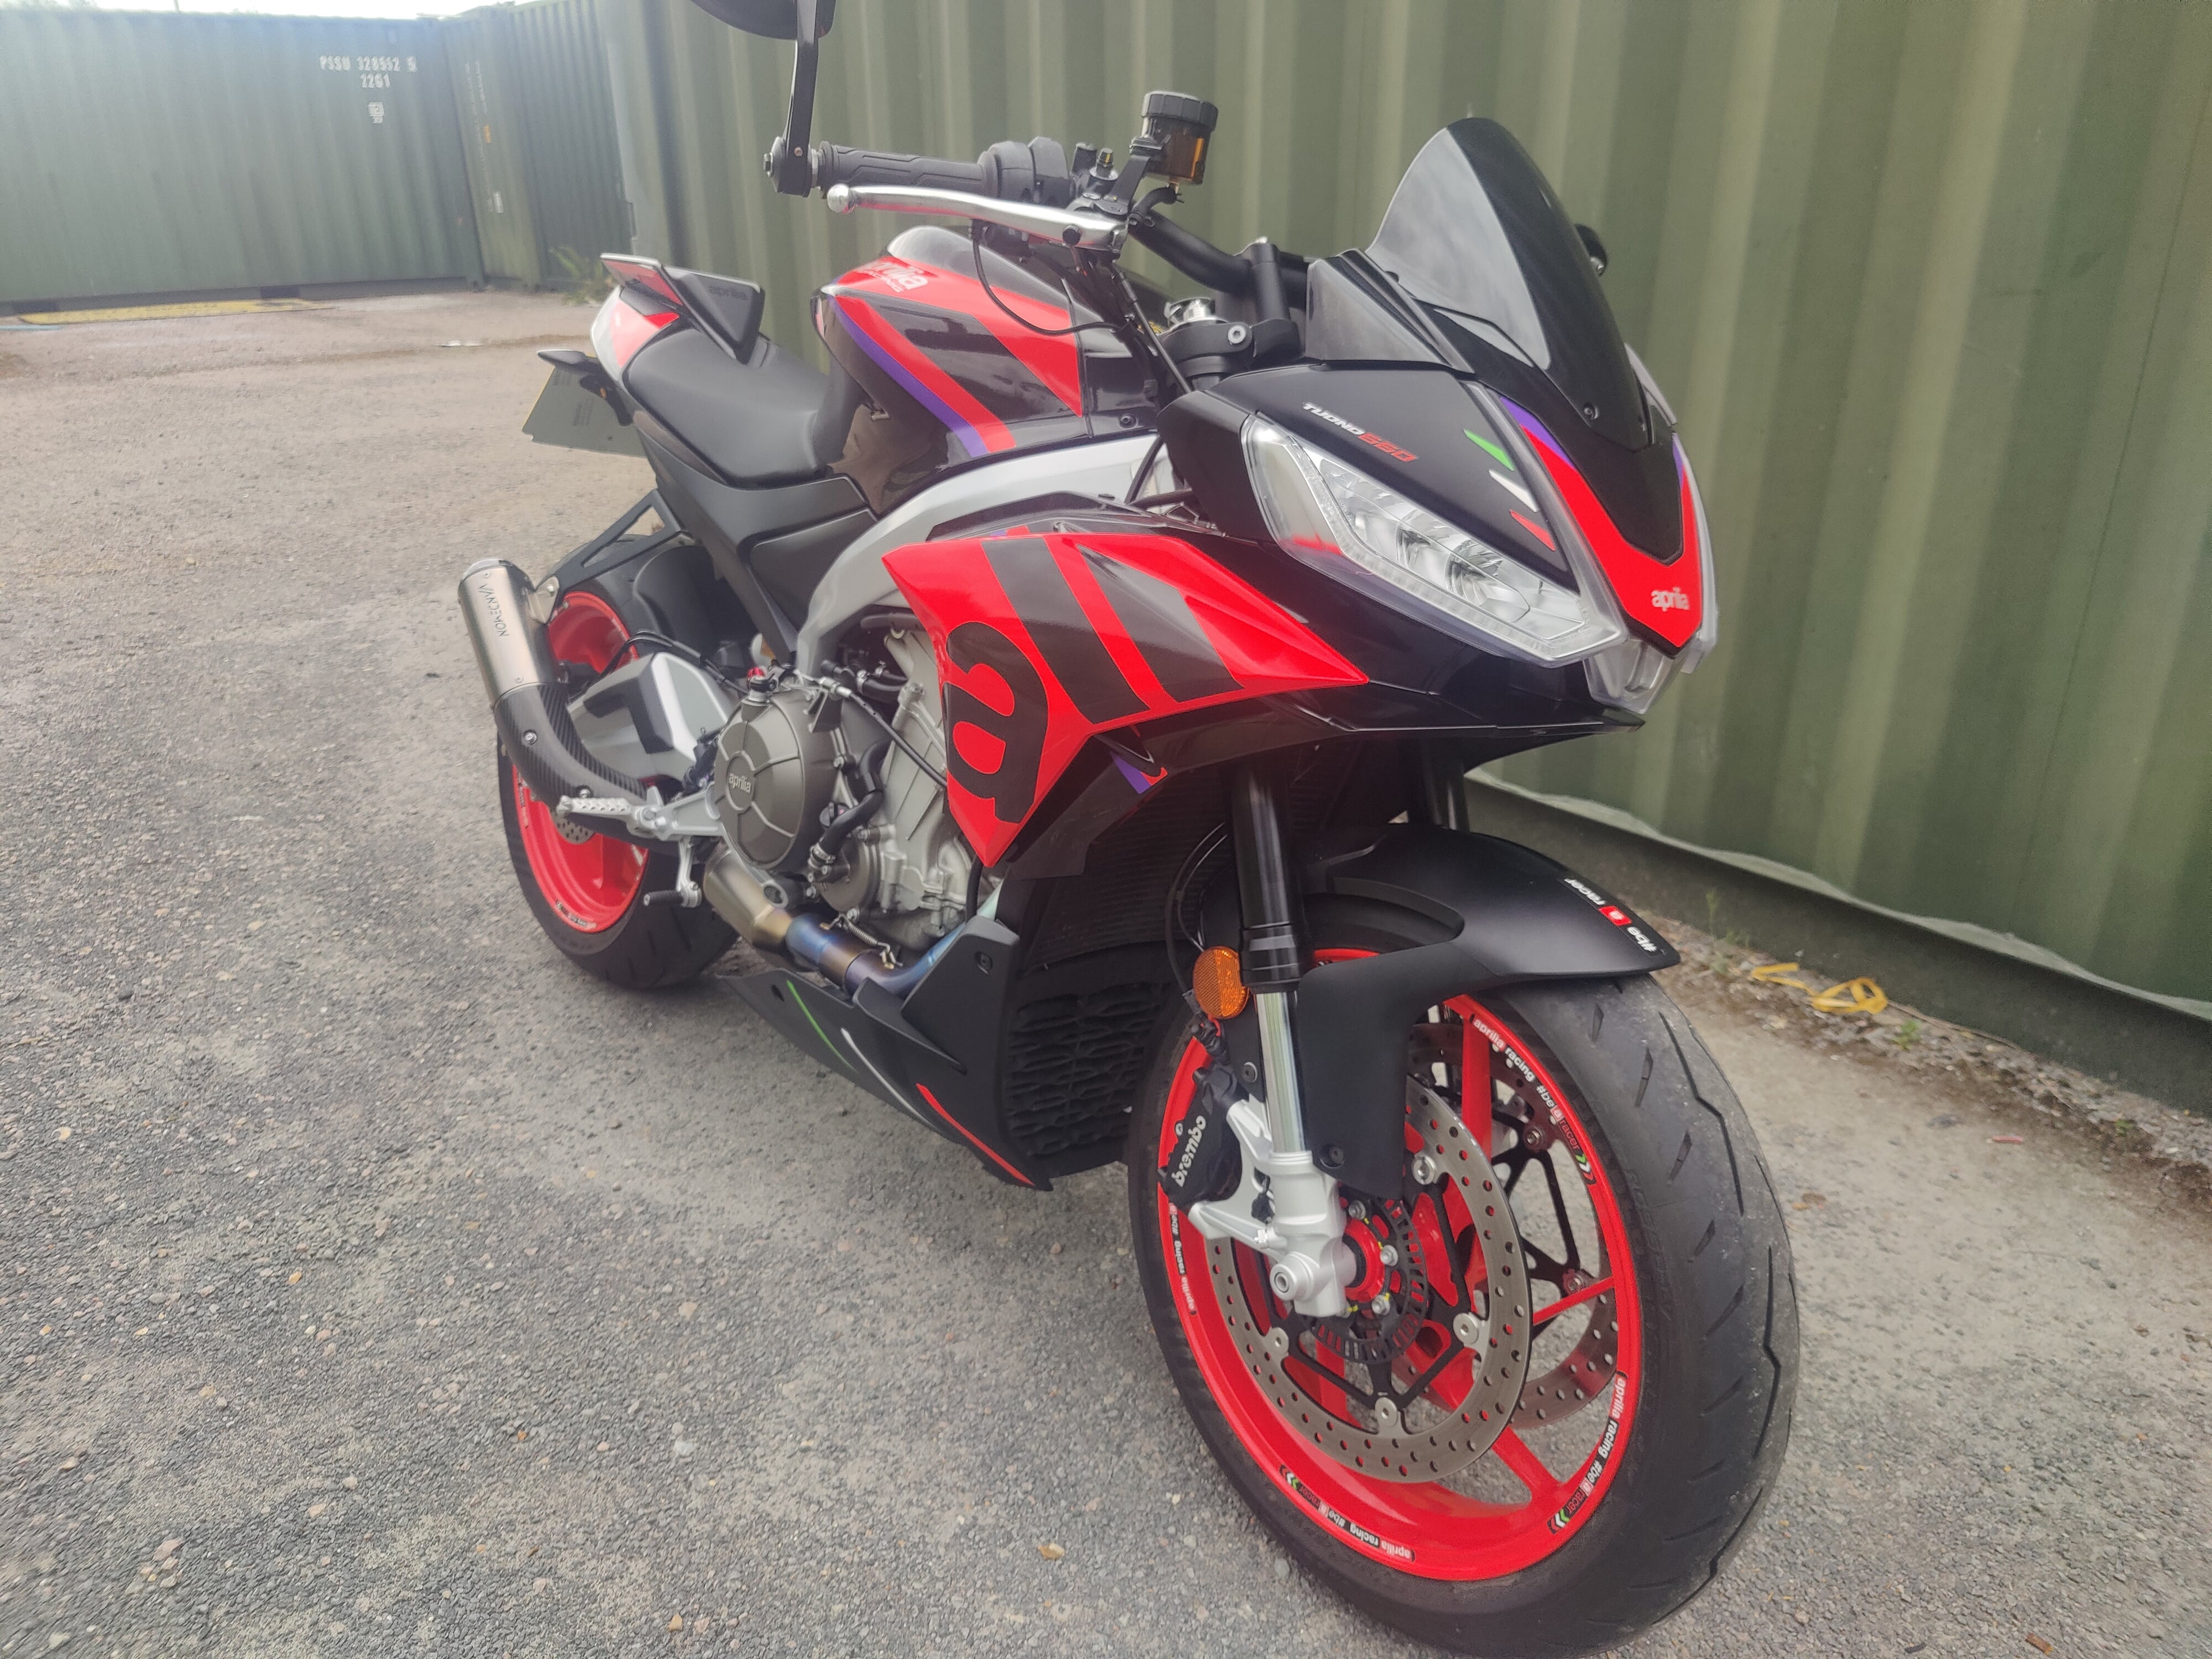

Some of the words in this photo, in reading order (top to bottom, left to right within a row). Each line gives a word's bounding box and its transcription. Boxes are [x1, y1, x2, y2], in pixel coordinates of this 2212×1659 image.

[319, 55, 350, 71] PSSU
[479, 584, 510, 637] VANDEMON
[729, 772, 752, 794] aprilia
[1564, 878, 1607, 905] racer
[1627, 926, 1658, 953] #be
[1474, 1019, 1504, 1048] aprilia
[1505, 1047, 1535, 1082] racing
[1536, 1085, 1555, 1108] #be
[1559, 1119, 1580, 1150] racer
[1172, 1115, 1206, 1187] brembo
[1612, 1377, 1626, 1419] aprilia
[1597, 1420, 1618, 1459] racing
[1587, 1459, 1603, 1483] #be
[1566, 1488, 1585, 1514] racer
[1350, 1522, 1379, 1547] racing
[1381, 1540, 1411, 1559] aprilia
